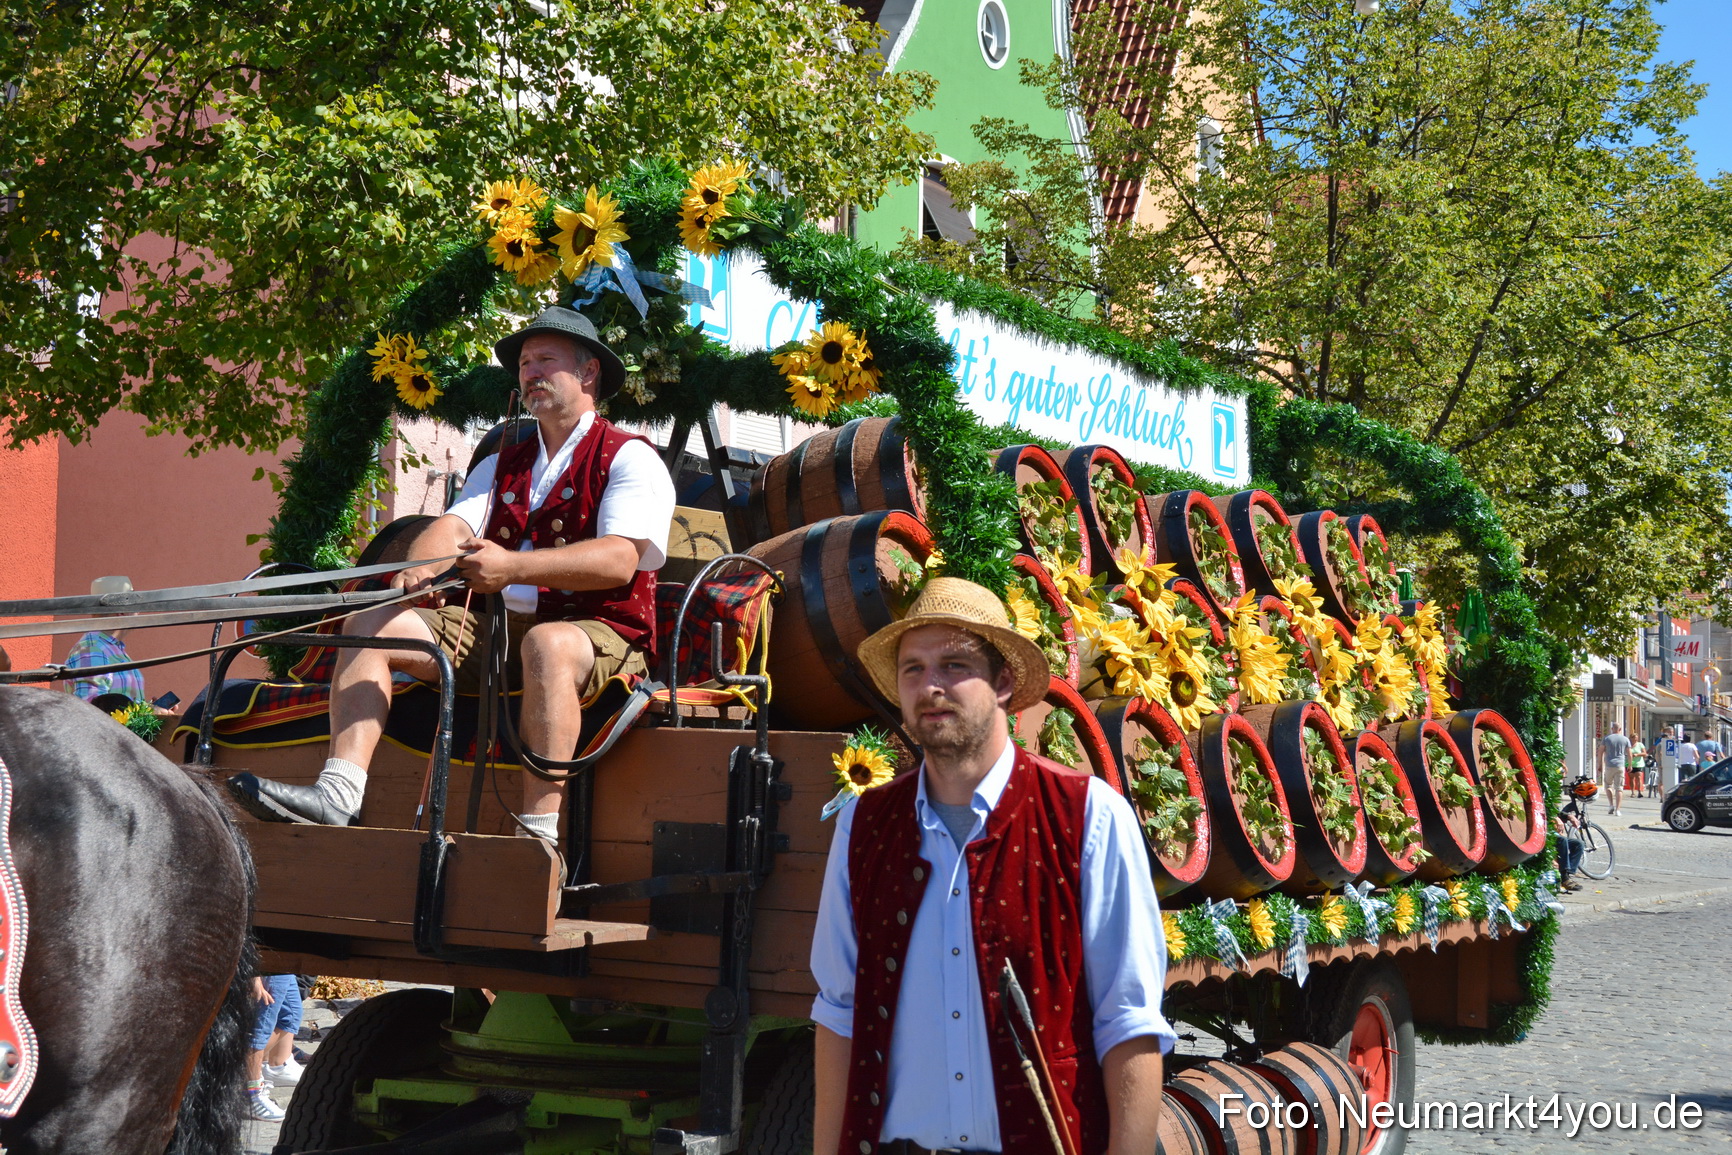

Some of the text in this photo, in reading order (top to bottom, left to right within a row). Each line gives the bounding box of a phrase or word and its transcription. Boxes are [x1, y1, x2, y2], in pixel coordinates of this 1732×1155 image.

[1002, 365, 1082, 428] guter
[1079, 373, 1193, 469] Schluck
[1674, 641, 1699, 657] H&M
